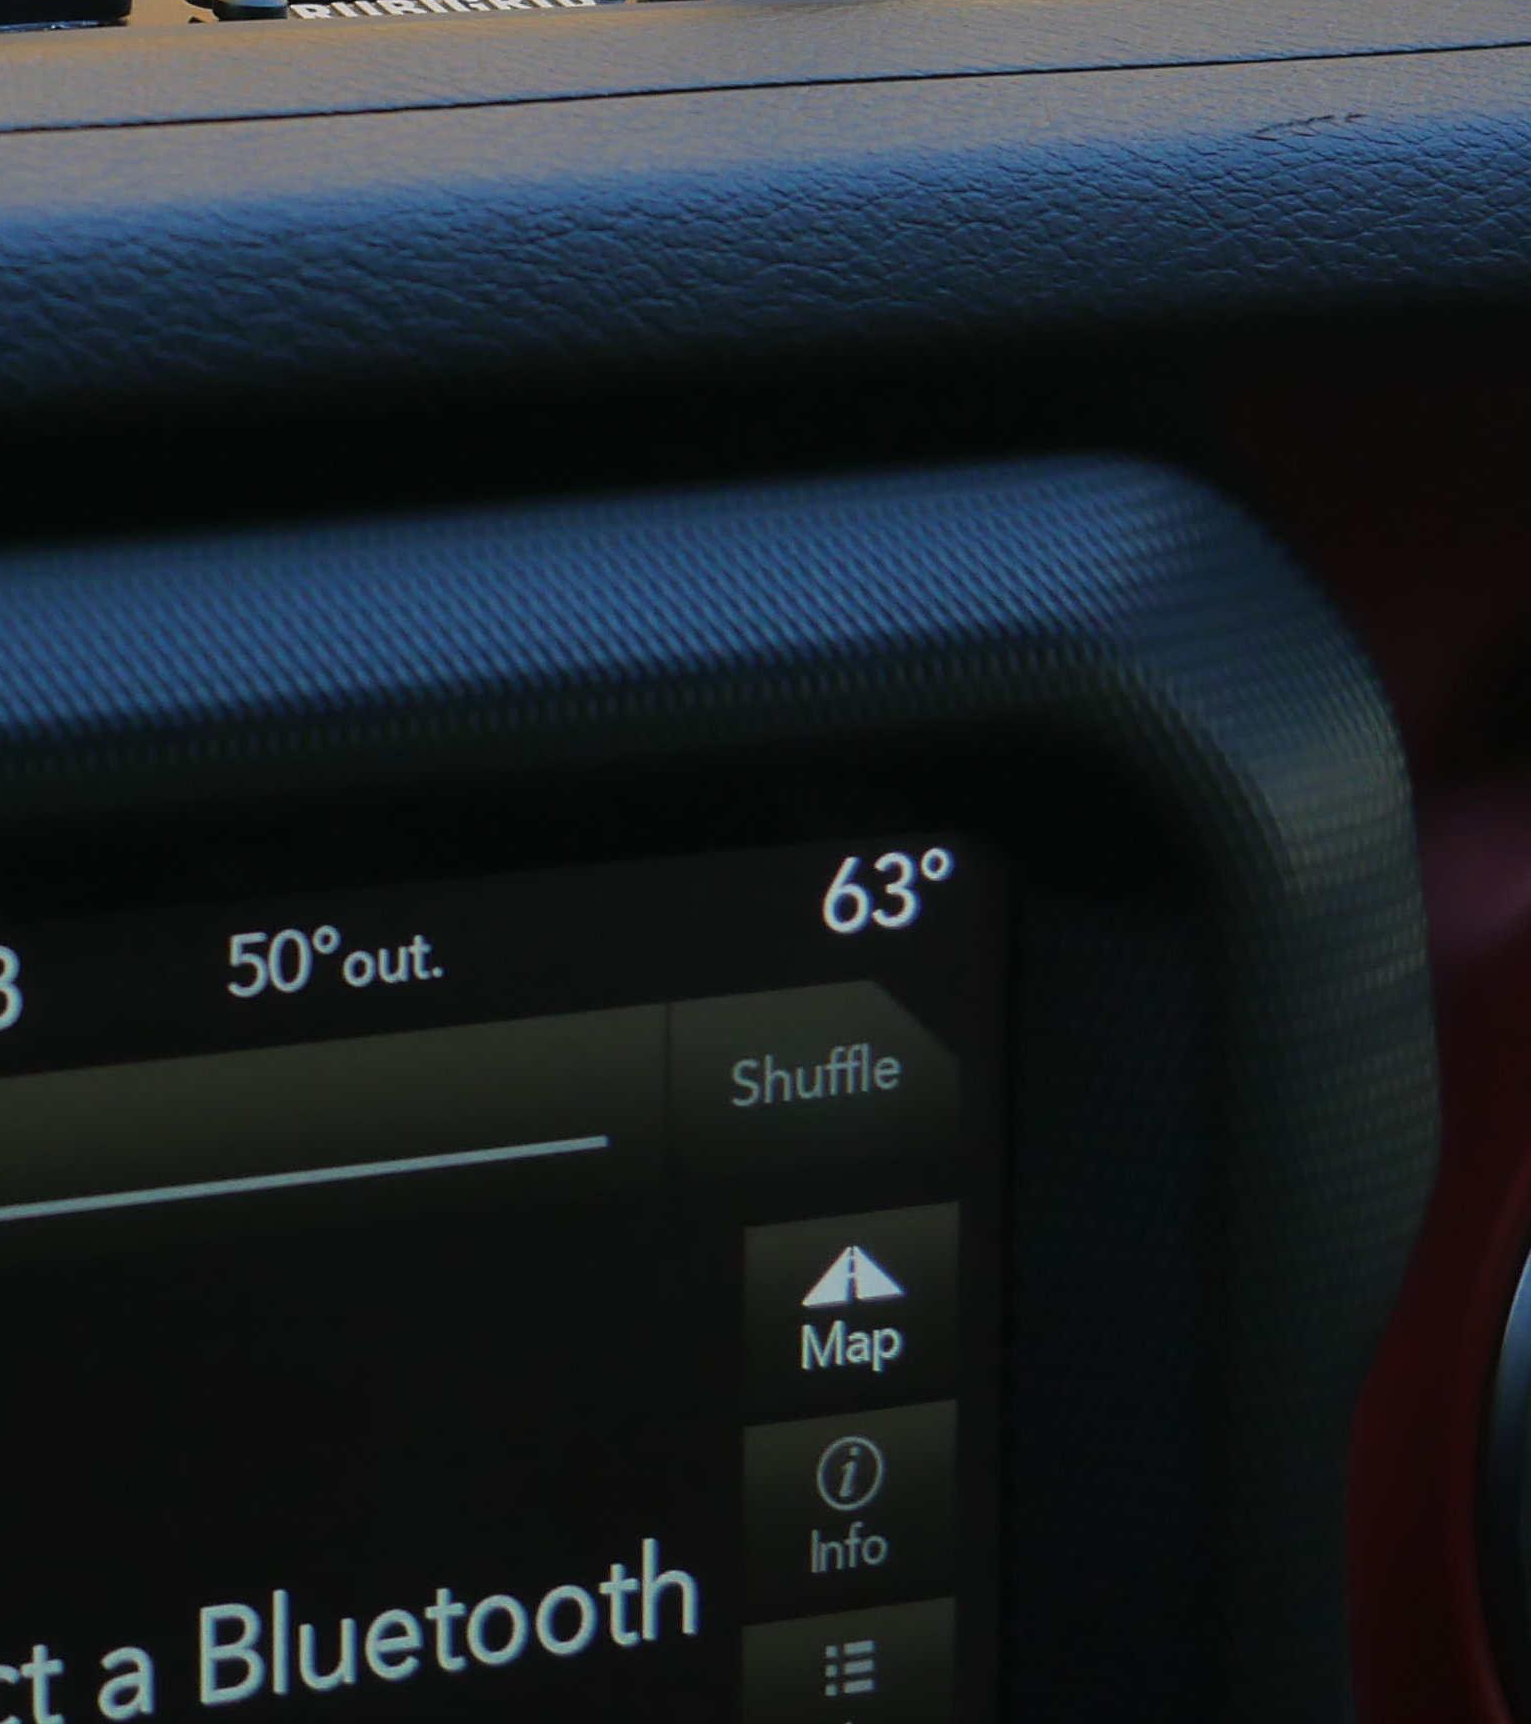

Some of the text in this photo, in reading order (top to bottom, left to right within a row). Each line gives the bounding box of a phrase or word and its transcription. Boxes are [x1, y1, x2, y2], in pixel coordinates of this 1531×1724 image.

[823, 848, 954, 933] 63°
[732, 1042, 902, 1107] Shuffle
[801, 1320, 904, 1372] Map
[811, 1521, 889, 1574] Info
[97, 1646, 155, 1721] a
[199, 1538, 699, 1706] Bluetooth
